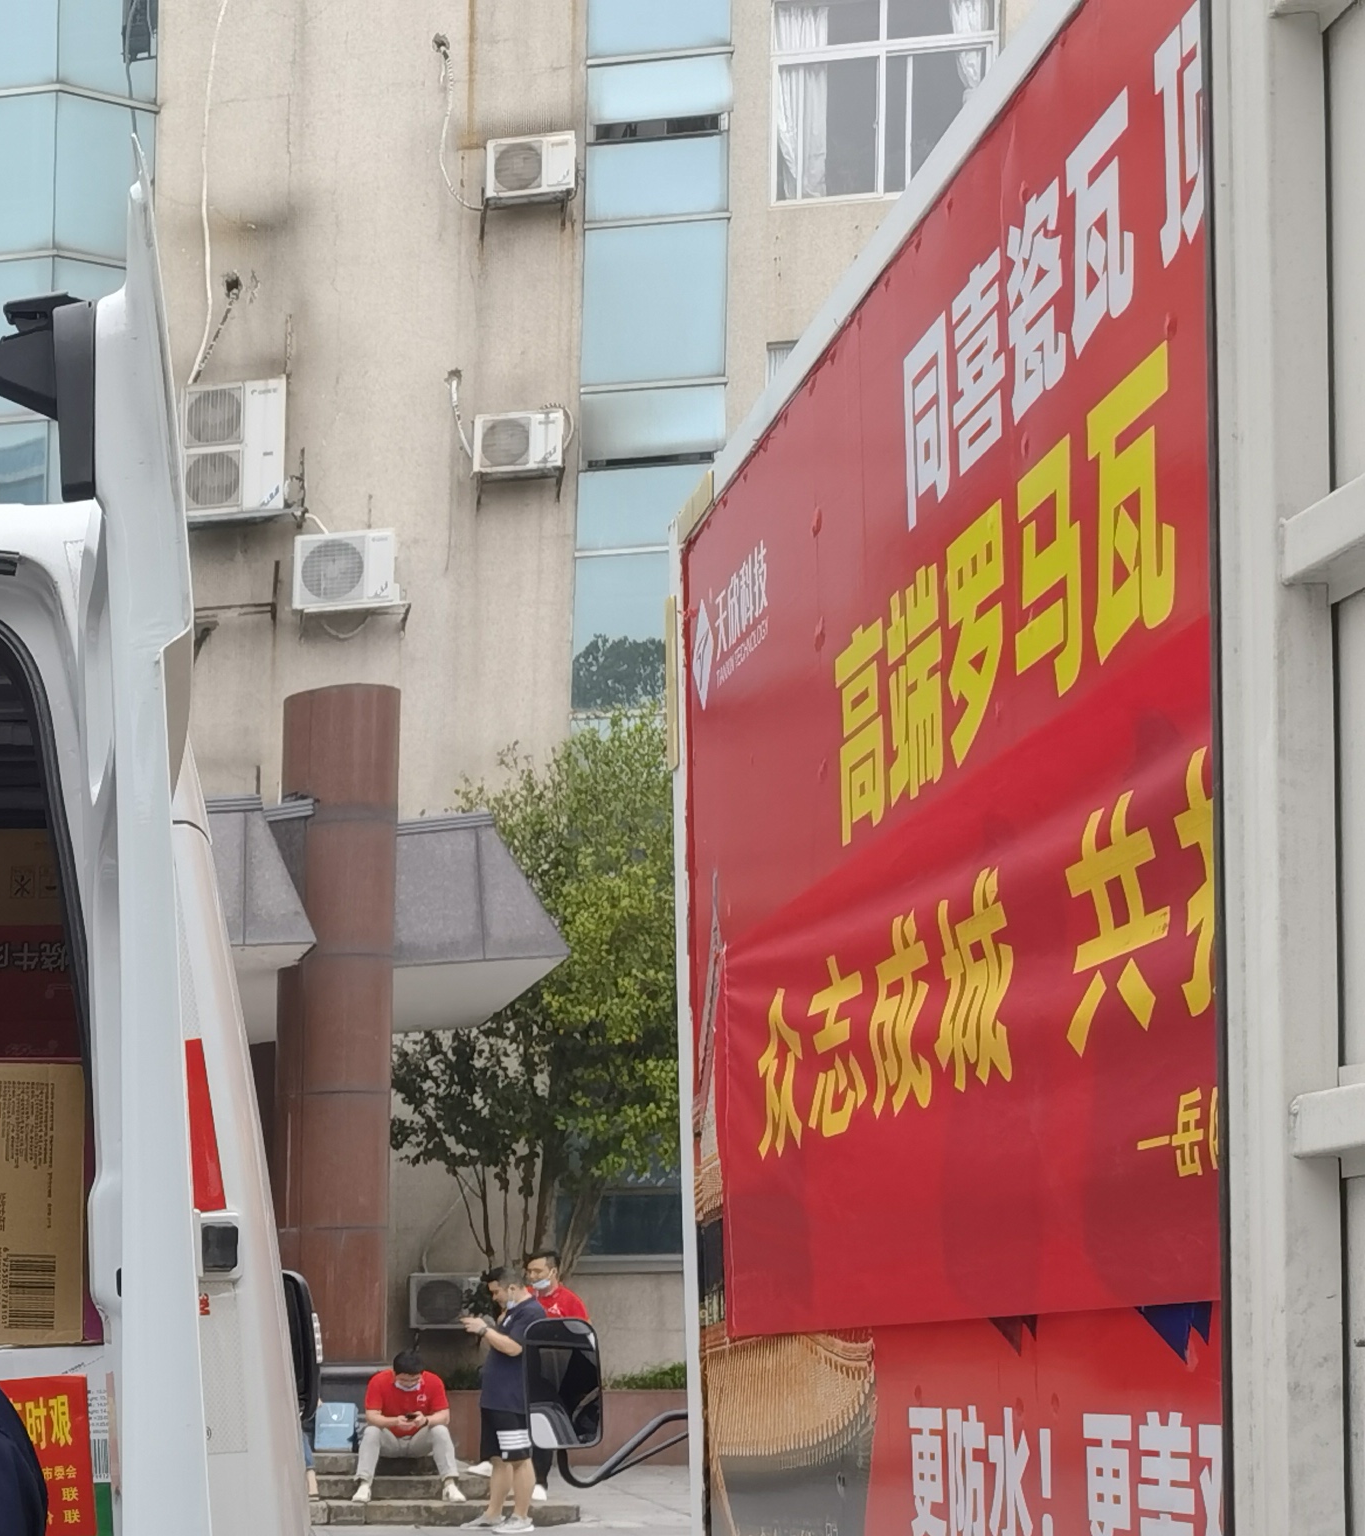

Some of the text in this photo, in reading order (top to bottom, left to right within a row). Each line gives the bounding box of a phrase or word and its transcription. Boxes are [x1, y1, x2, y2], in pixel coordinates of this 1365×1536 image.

[904, 86, 1134, 530] 同喜瓷瓦
[833, 340, 1175, 846] 高端罗马瓦
[758, 867, 1014, 1160] 众志成城
